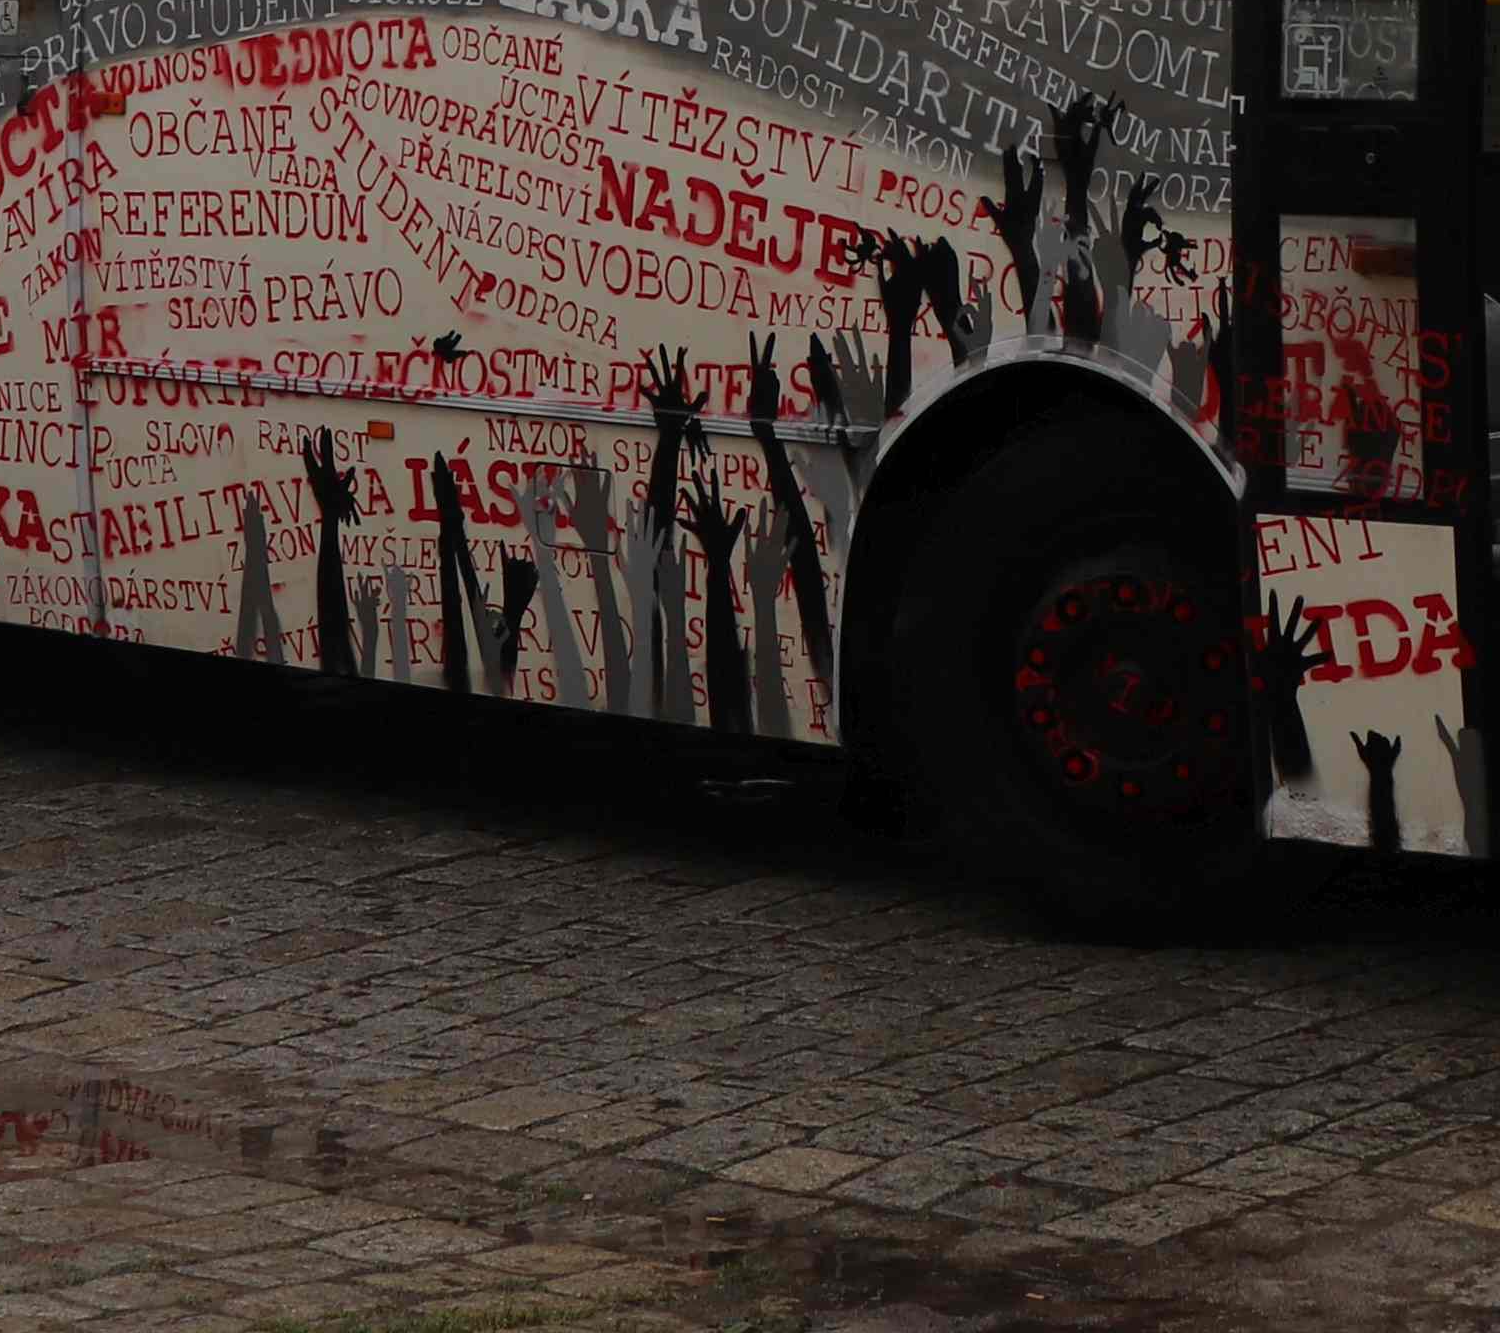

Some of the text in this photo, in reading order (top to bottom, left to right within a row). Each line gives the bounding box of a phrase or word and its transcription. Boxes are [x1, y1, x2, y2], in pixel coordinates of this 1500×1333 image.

[19, 2, 149, 83] PRÁVO
[99, 44, 228, 97] VOLNOST
[233, 16, 438, 90] JEDNOTA
[441, 23, 565, 77] OBČANÉ
[712, 35, 845, 118] RADOST
[128, 91, 299, 159] OBČANÉ
[342, 72, 605, 172] ROVNOPRÁVNOST
[498, 68, 579, 133] ÚCTA
[574, 68, 865, 195] VÍTĚZSTVÍ
[858, 107, 977, 184] ZÁKON
[308, 84, 485, 313] STUDENT
[397, 134, 595, 227] PŘÁTELSTVÍ
[99, 188, 370, 244] REFERENDUM
[443, 200, 548, 262] NÁZOR
[594, 154, 863, 288] NADĚJE
[93, 248, 253, 294] VÍTĚZSTVÍ
[262, 257, 404, 323] PRÁVO
[540, 232, 761, 321] SVOBODA
[167, 292, 258, 330] SLOVO
[473, 267, 620, 350] PODPORA
[537, 345, 603, 398] MÍR
[145, 420, 236, 458] SLOVO
[4, 566, 232, 616] ZÁKONODÁRSTVÍ
